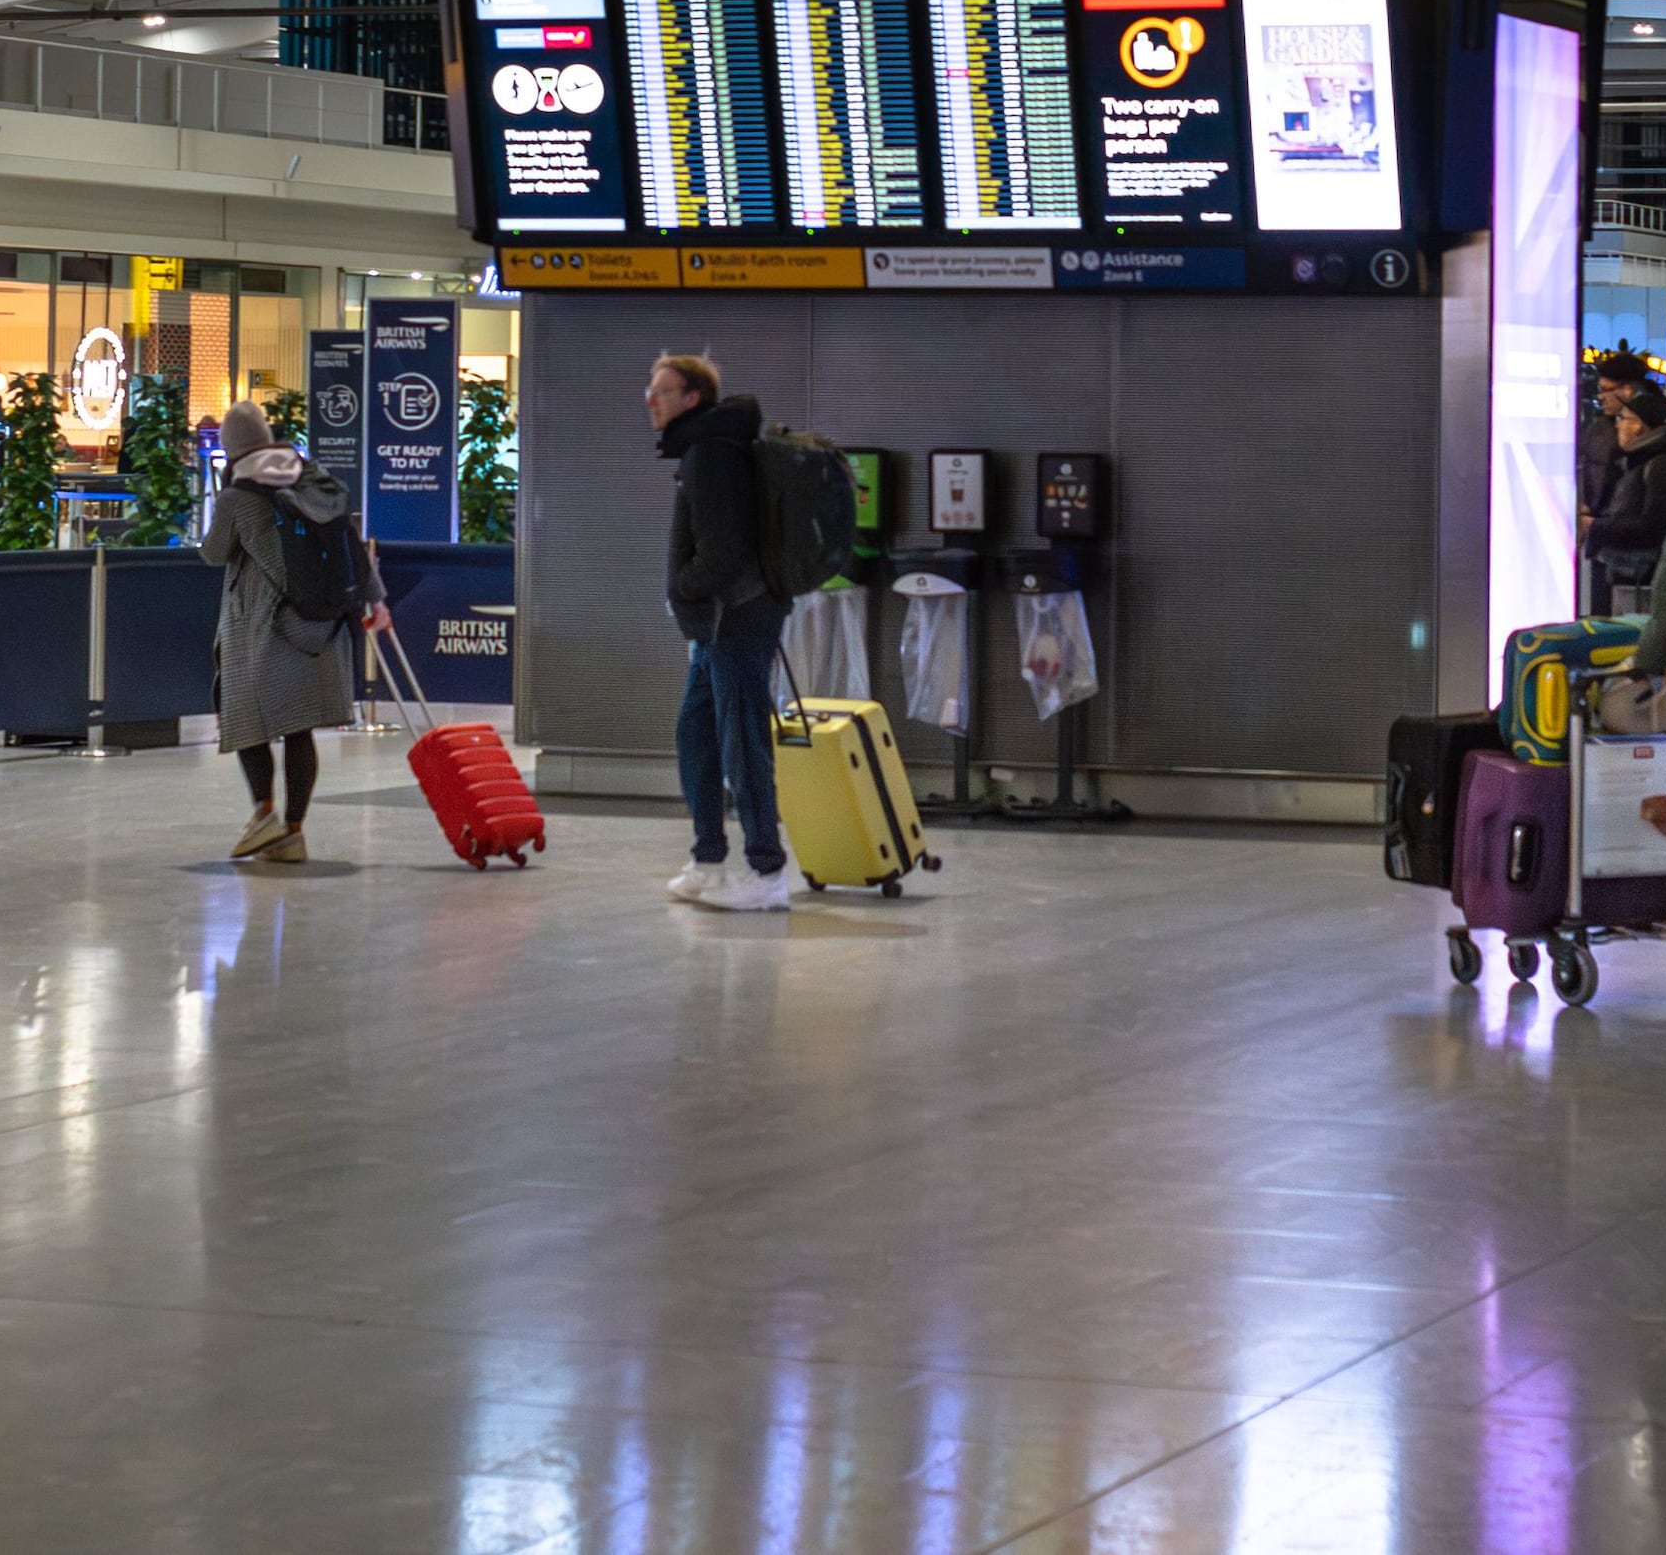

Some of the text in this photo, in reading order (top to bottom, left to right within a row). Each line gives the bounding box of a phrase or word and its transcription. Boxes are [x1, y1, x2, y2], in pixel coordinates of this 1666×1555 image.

[1101, 97, 1143, 115] Two
[1103, 251, 1184, 267] Assistance
[377, 327, 427, 339] BRITISH
[373, 338, 427, 350] AIRWAYS
[377, 381, 403, 393] STEP
[317, 437, 357, 446] SECURITY
[377, 445, 443, 457] GET READY
[389, 457, 430, 469] TO FLY
[438, 619, 507, 638] BRITISH
[434, 637, 509, 655] AIRWAYS
